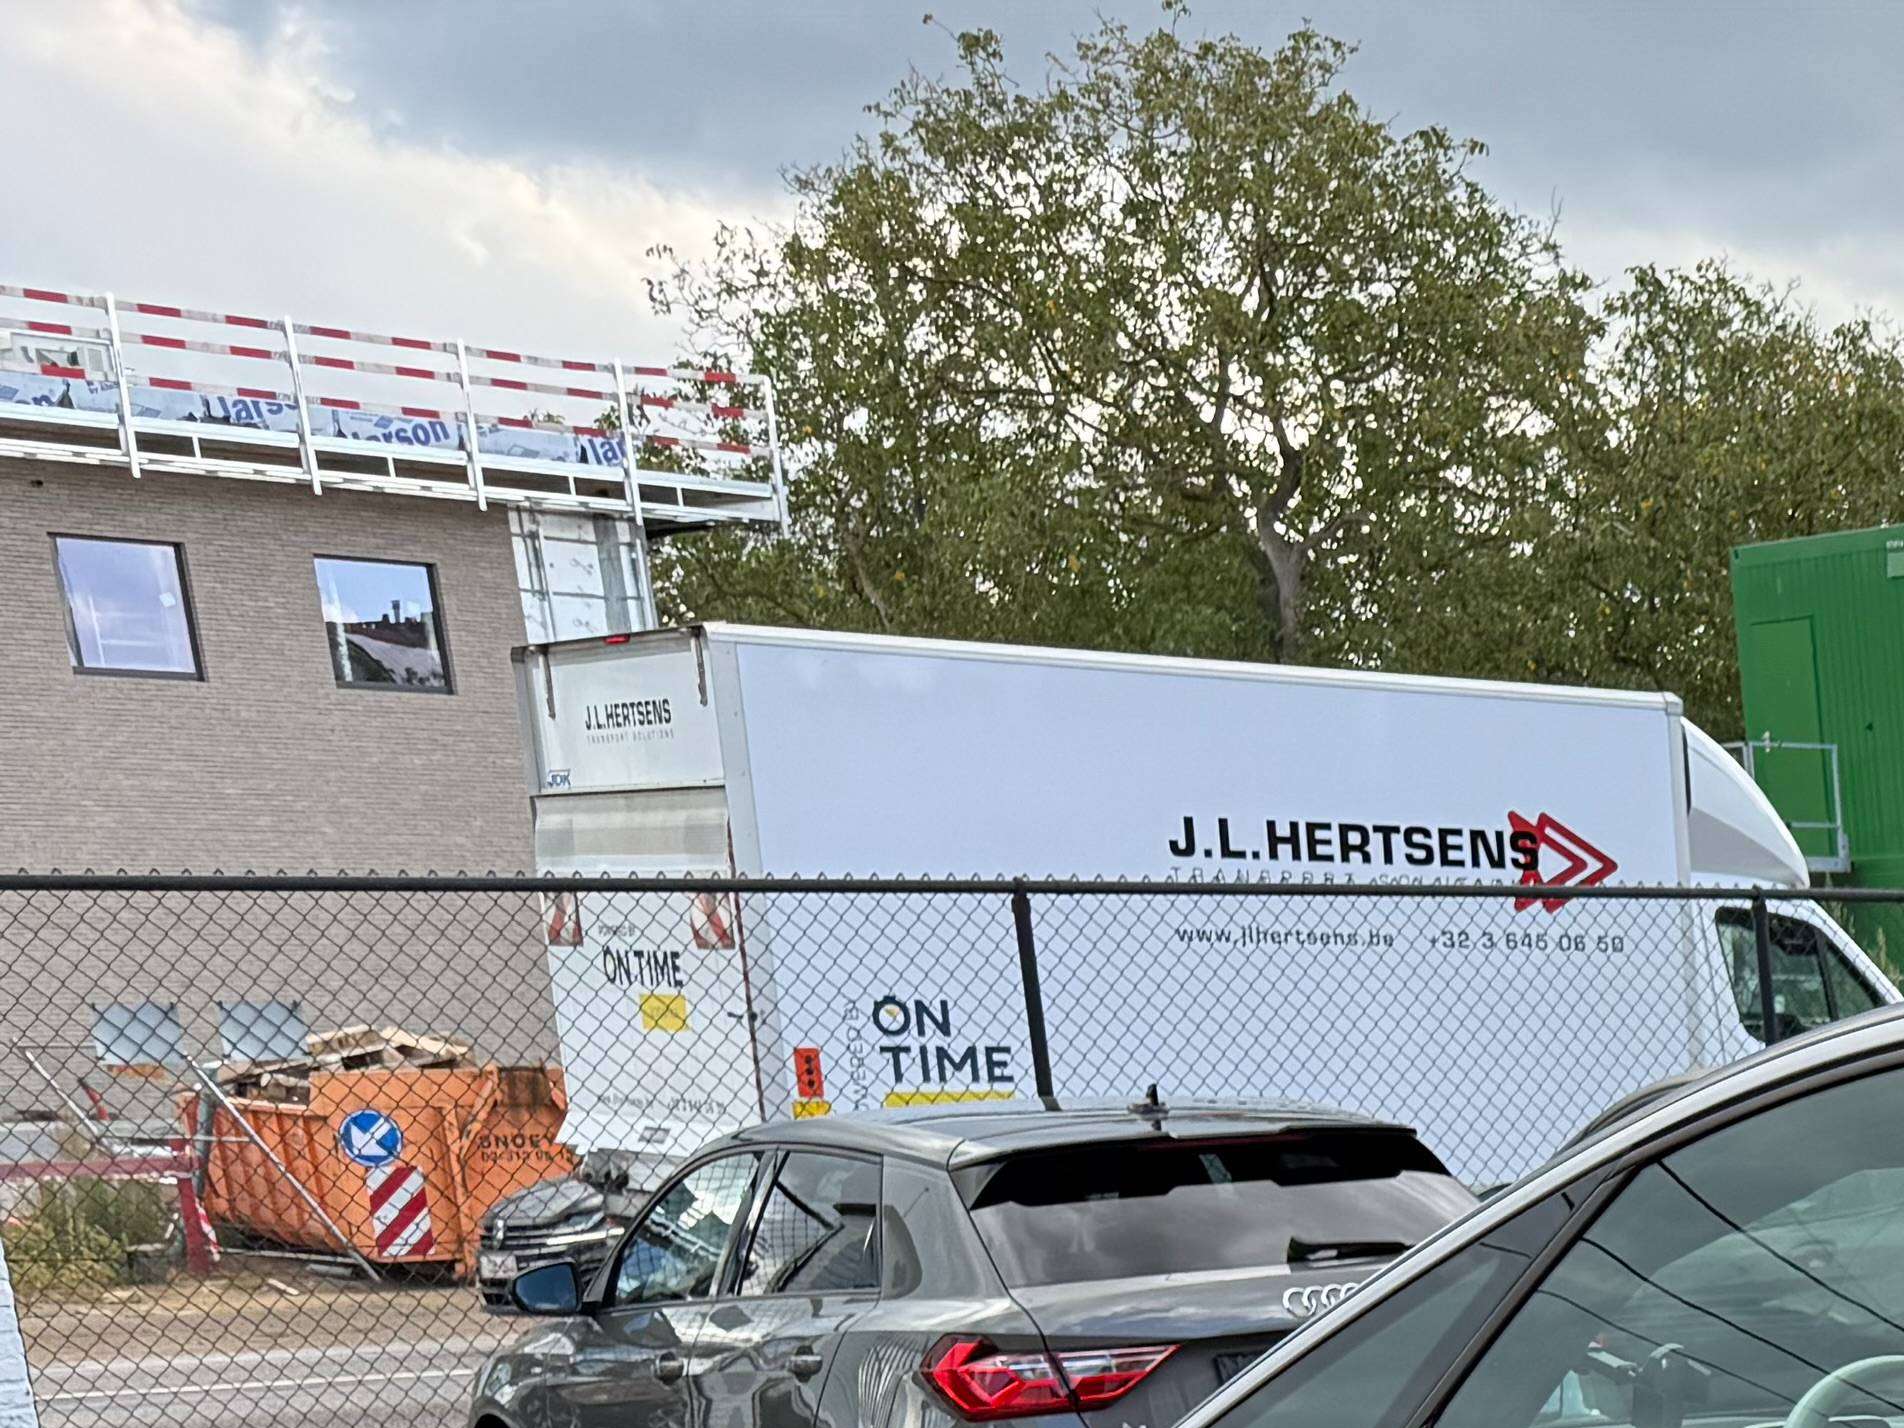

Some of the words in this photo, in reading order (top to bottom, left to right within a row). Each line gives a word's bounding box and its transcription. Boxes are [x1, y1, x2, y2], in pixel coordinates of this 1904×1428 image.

[585, 698, 672, 730] J.L.HERTSENS
[1169, 816, 1539, 871] J.L.HERTSENS
[873, 995, 951, 1037] ON
[880, 1046, 1014, 1083] TIME
